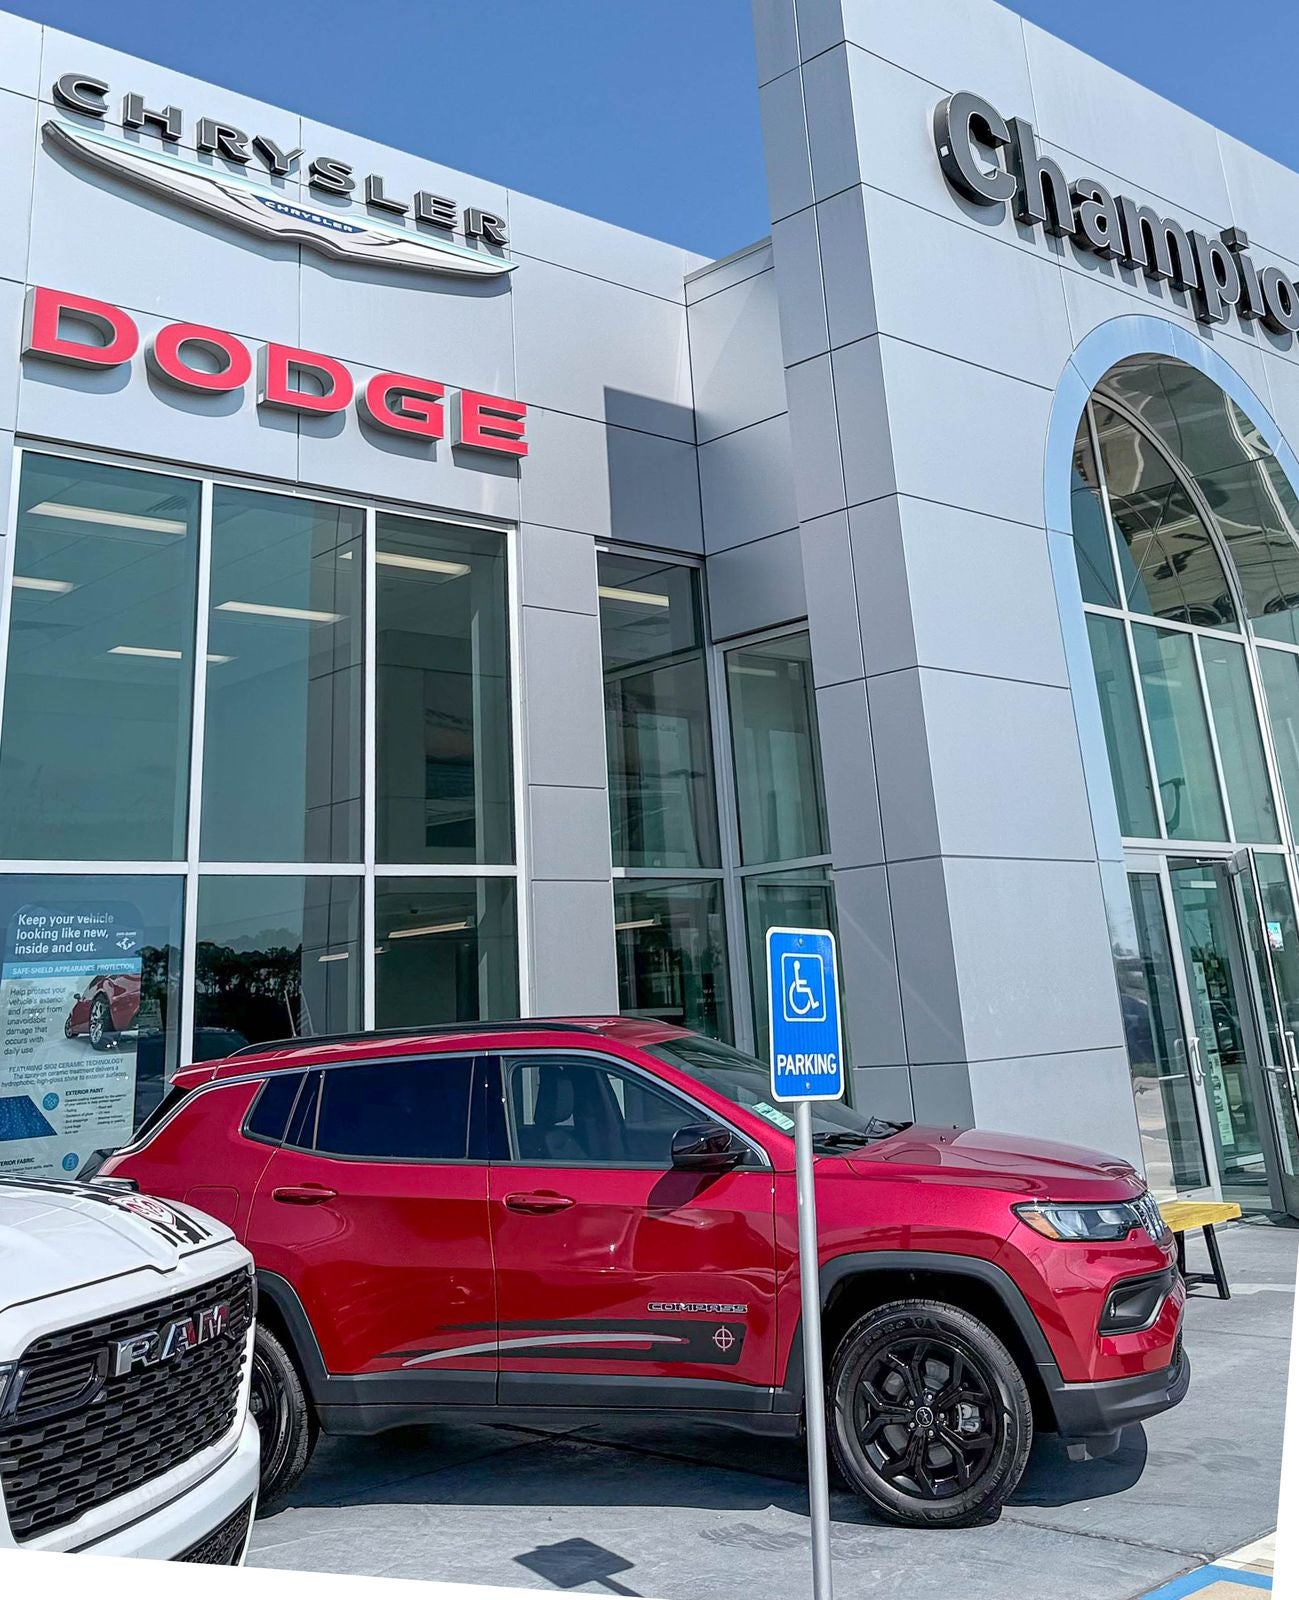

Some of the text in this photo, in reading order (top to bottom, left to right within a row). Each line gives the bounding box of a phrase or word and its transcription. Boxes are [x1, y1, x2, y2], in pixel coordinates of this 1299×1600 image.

[53, 72, 509, 245] CHRYSLER
[264, 200, 353, 233] CHRYSLER
[933, 90, 1299, 336] Champio
[22, 286, 529, 458] DODGE
[18, 912, 114, 927] Keep your vehicle
[16, 928, 58, 941] looking
[61, 927, 81, 939] like
[83, 929, 109, 939] new,
[15, 941, 97, 955] inside and out.
[12, 963, 134, 975] SAFE-SHIELD APPEARANCE PROTECTION
[8, 1007, 21, 1016] and
[46, 1005, 63, 1014] from
[7, 1017, 47, 1026] unavoidable
[6, 1026, 48, 1036] damage that
[5, 1037, 28, 1046] occurs
[4, 1047, 34, 1057] daily use
[58, 1061, 85, 1069] CERAMIC
[86, 1058, 124, 1067] TECHNOLOGY
[777, 1053, 836, 1076] PARKING
[65, 1089, 89, 1097] EXTERIOR
[647, 1302, 748, 1313] COMPASS
[107, 1301, 230, 1377] RAM
